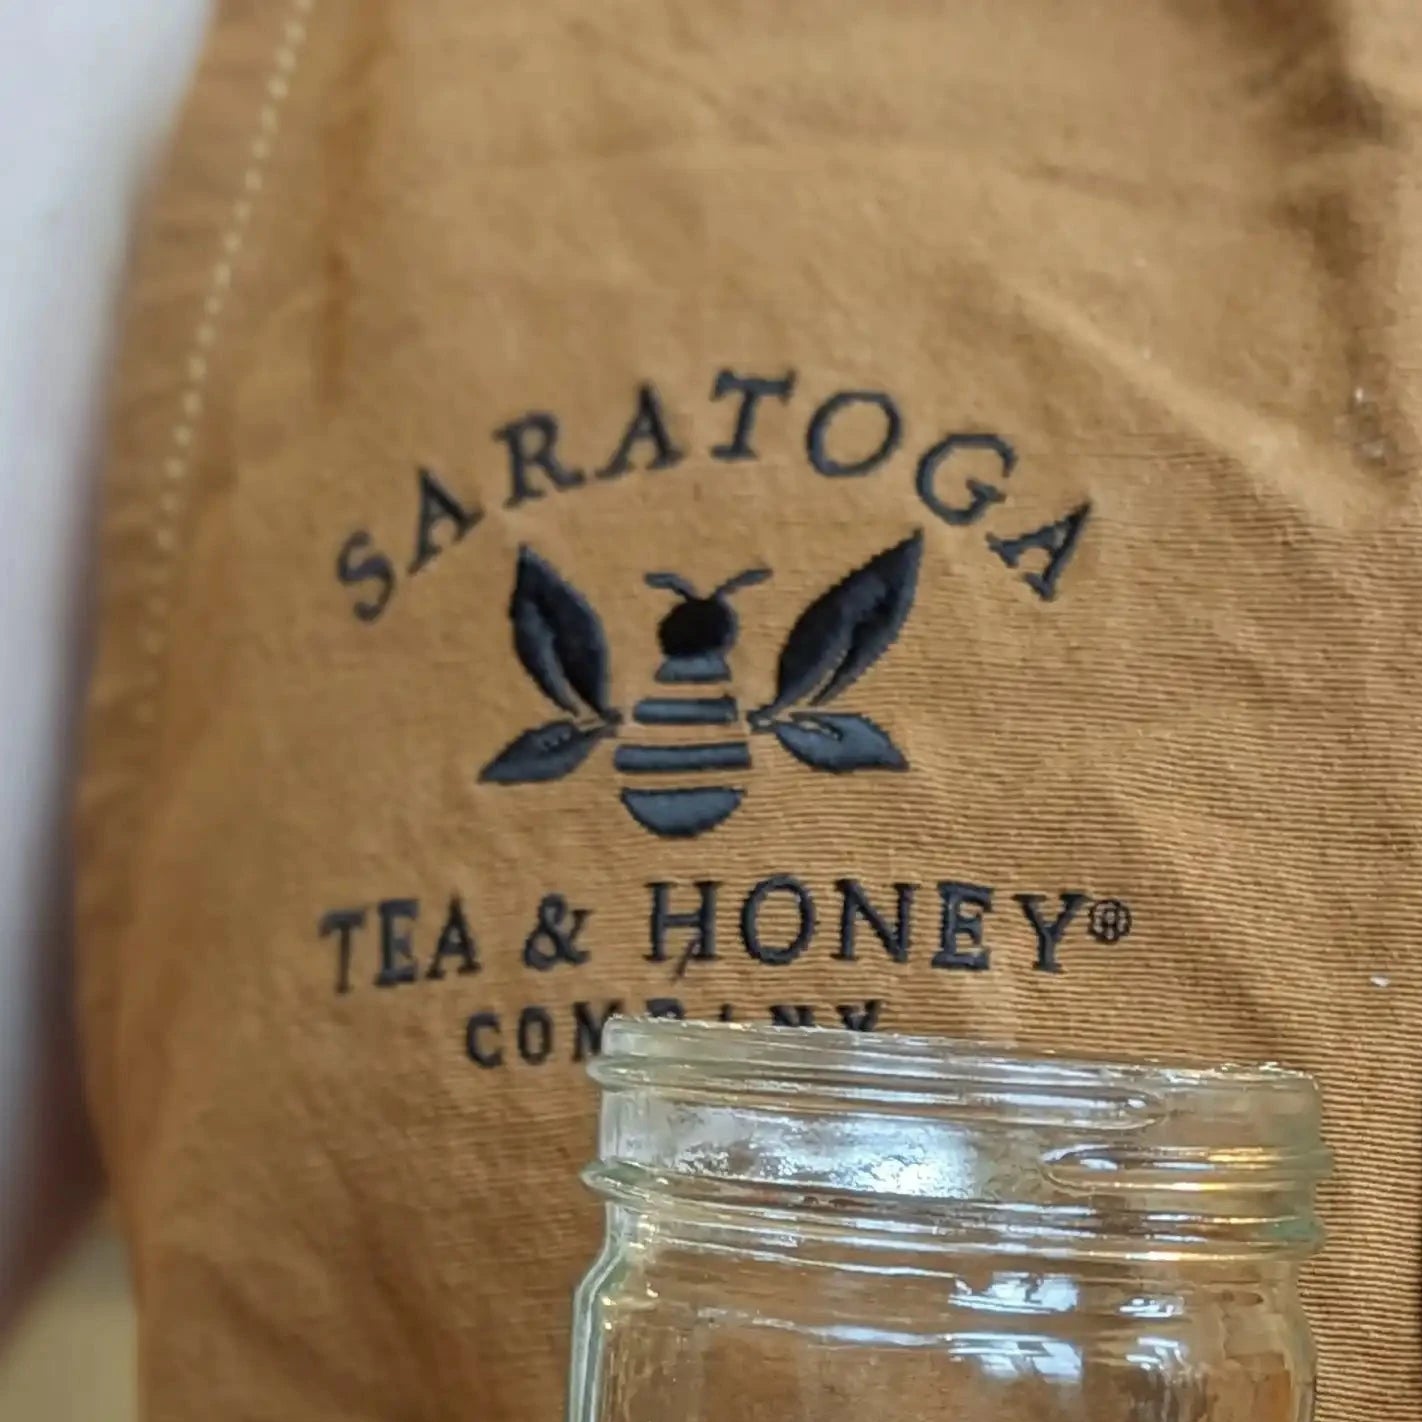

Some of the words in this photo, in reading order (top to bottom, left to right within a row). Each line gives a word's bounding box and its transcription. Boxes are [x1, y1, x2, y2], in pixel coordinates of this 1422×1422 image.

[335, 368, 1093, 623] SARATOGA
[318, 893, 481, 994] TEA
[522, 892, 592, 970] &
